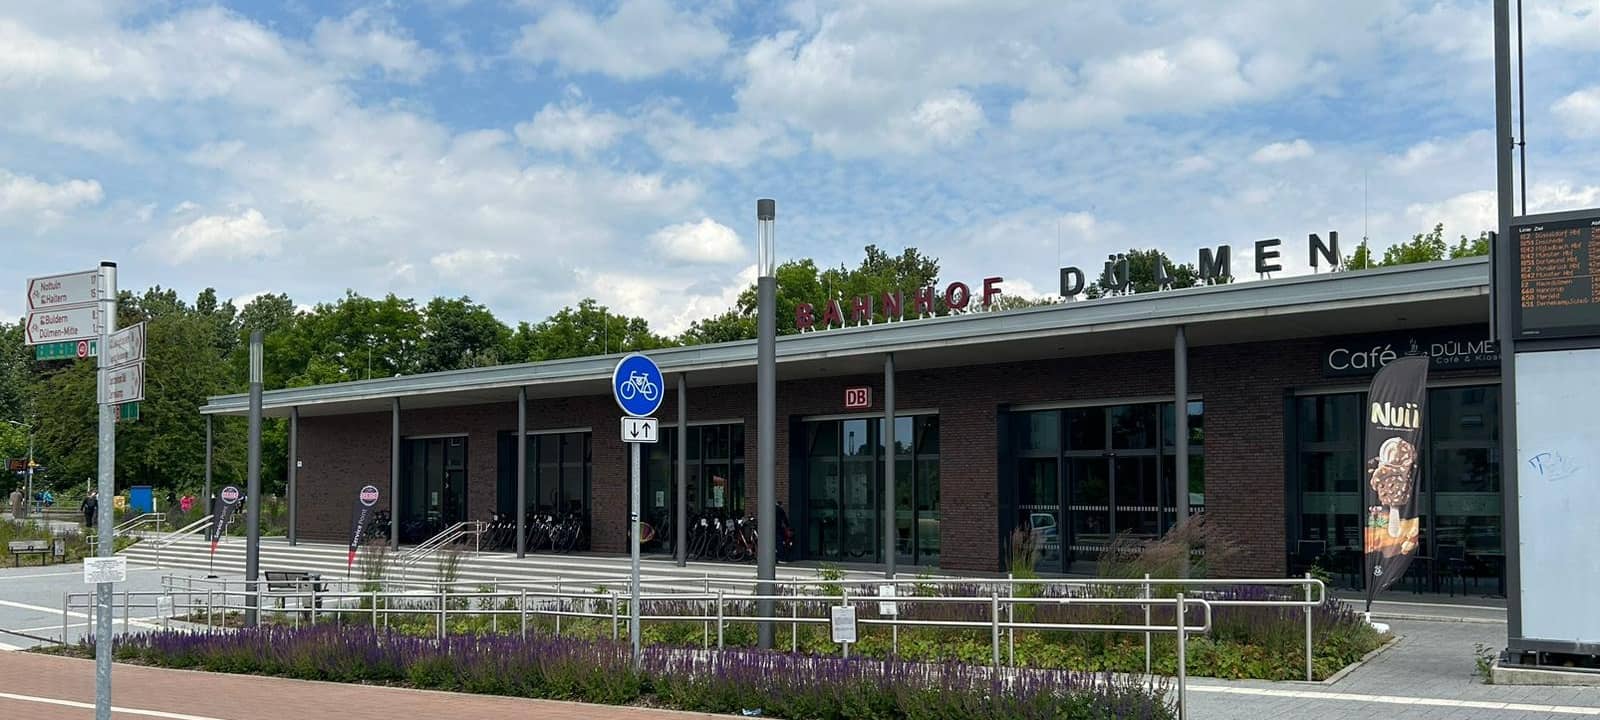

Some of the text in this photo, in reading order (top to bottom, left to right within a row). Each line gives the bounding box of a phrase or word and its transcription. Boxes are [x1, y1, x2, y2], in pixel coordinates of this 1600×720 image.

[795, 231, 1339, 329] BAHNHOF DÜLMEN
[1329, 344, 1397, 369] Café
[1431, 340, 1494, 356] DÜLME
[847, 389, 866, 406] DB
